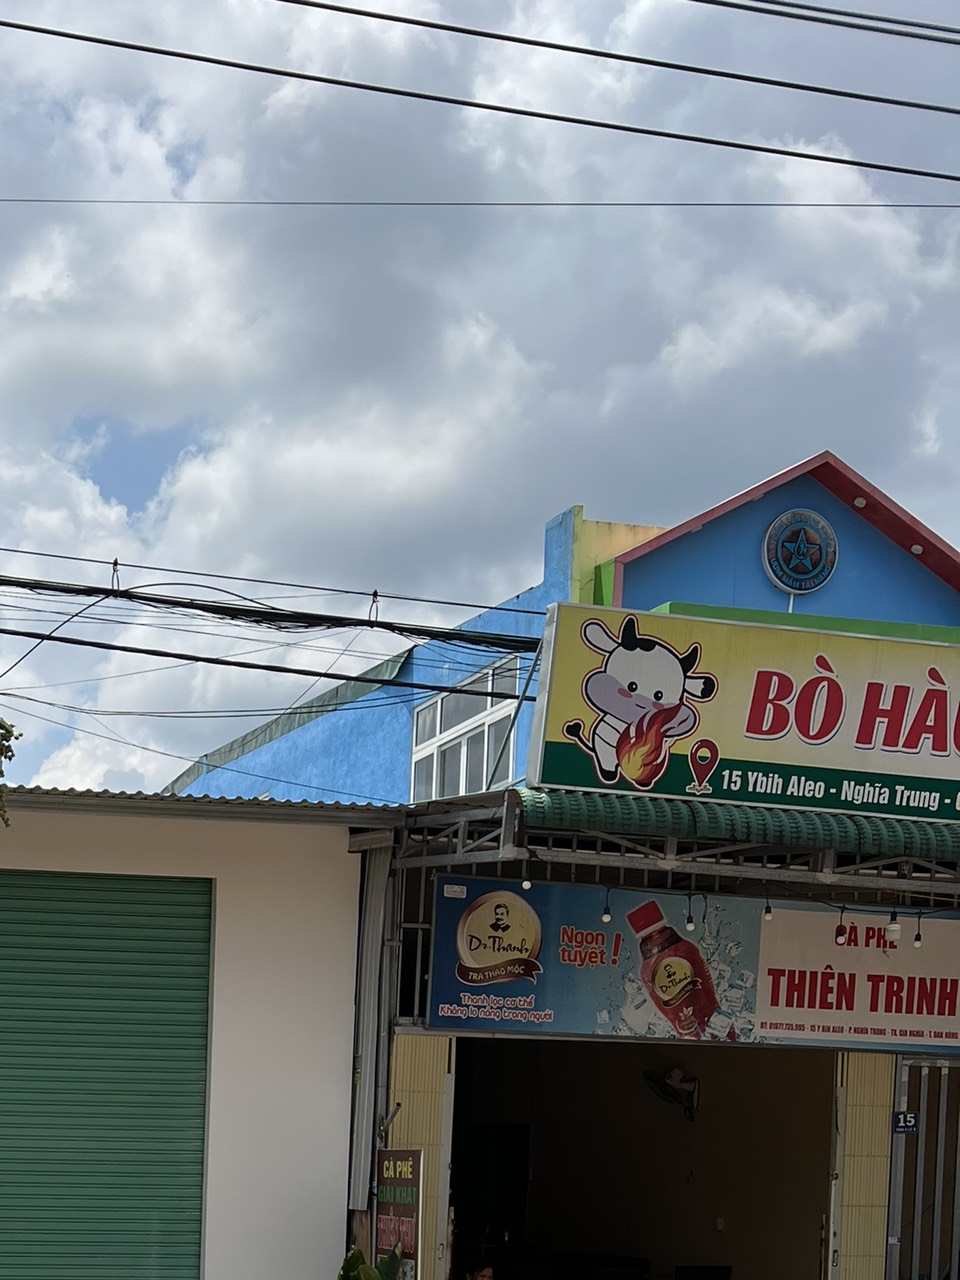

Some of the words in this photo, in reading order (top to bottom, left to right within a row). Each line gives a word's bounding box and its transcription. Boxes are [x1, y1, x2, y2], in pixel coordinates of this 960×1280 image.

[744, 654, 846, 743] BÒ
[854, 666, 960, 755] HÀ
[720, 768, 742, 791] 15
[747, 771, 783, 795] Ybih
[786, 775, 825, 798] Aleo
[840, 780, 890, 805] Nghĩa
[895, 785, 940, 812] Trung
[560, 925, 606, 949] Ngon
[559, 945, 607, 968] tuyệt
[767, 964, 856, 1011] THIÊN
[867, 974, 959, 1017] TRINH
[439, 1004, 468, 1018] Không
[469, 1006, 478, 1017] lo
[502, 1008, 528, 1022] trong
[898, 1113, 915, 1126] 15
[383, 1157, 394, 1178] CÀ
[396, 1157, 413, 1178] PHÊ
